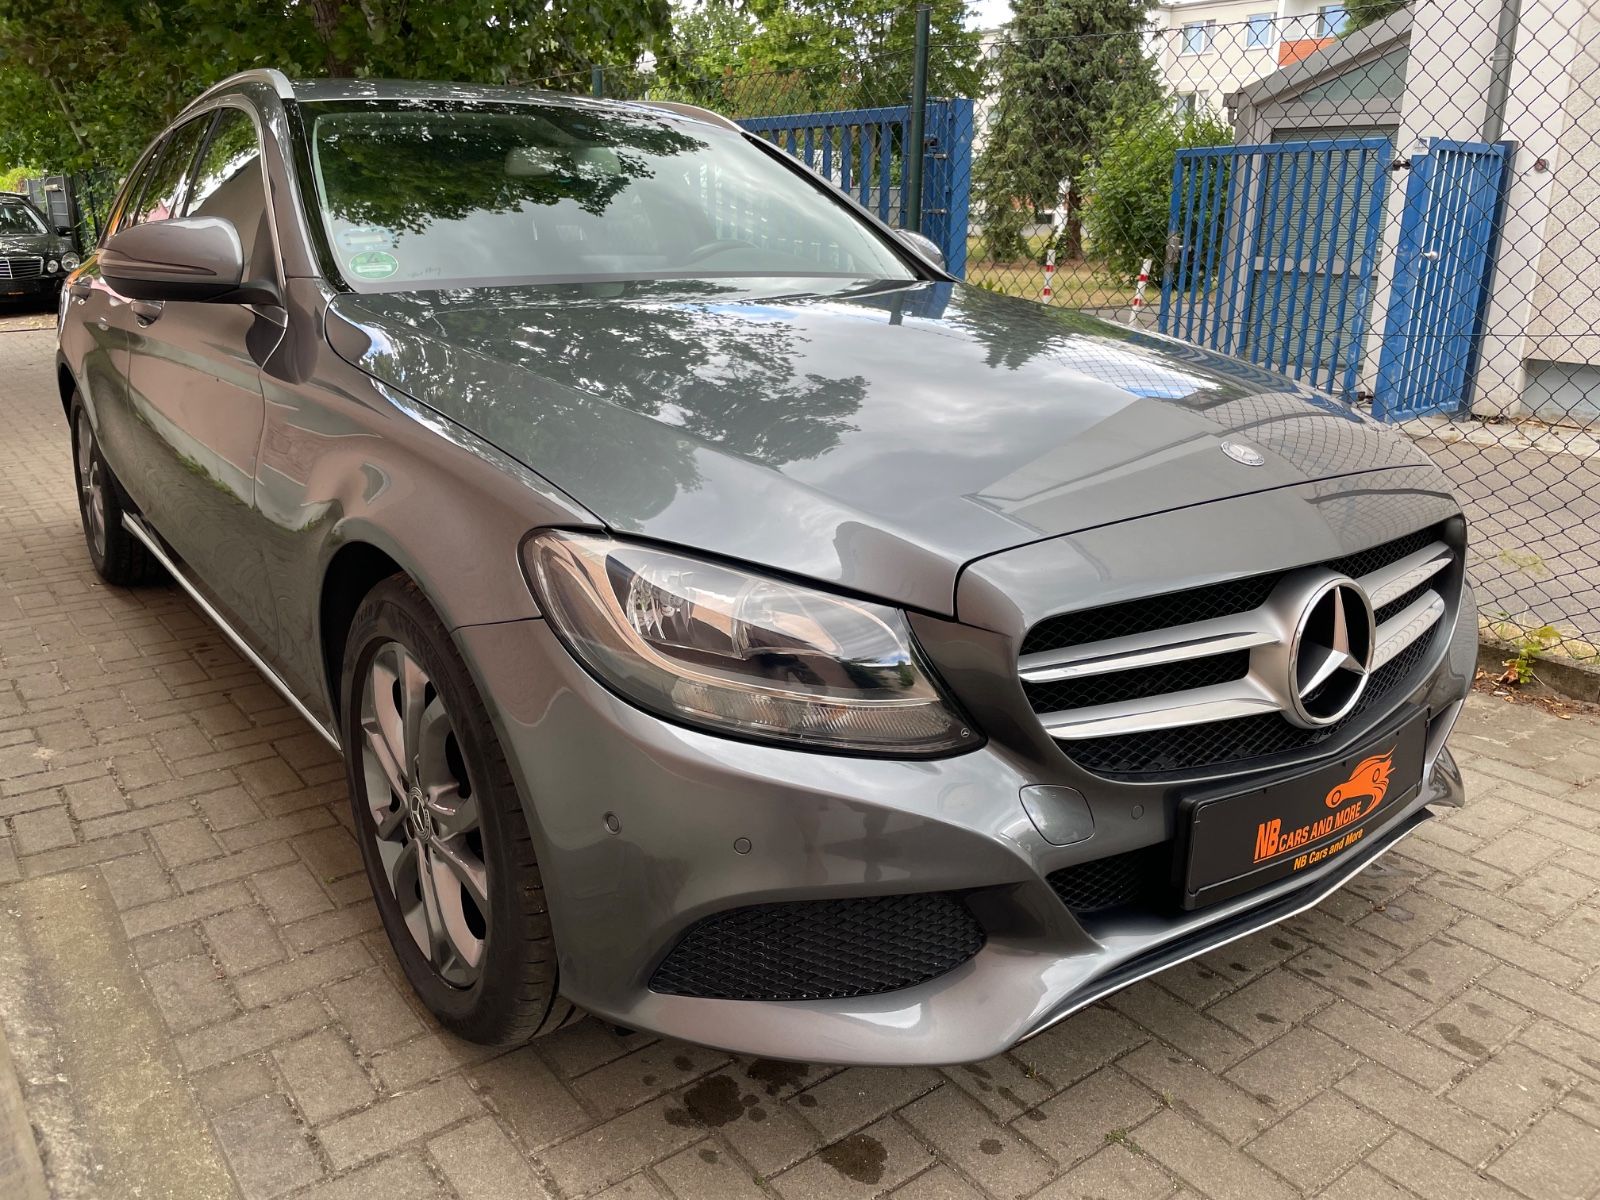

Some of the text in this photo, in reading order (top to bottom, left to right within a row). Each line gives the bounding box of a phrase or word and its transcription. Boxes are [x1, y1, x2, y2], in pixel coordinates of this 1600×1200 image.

[1254, 801, 1362, 860] NB CARS AND MORE
[1293, 828, 1364, 871] NB Cars and More
